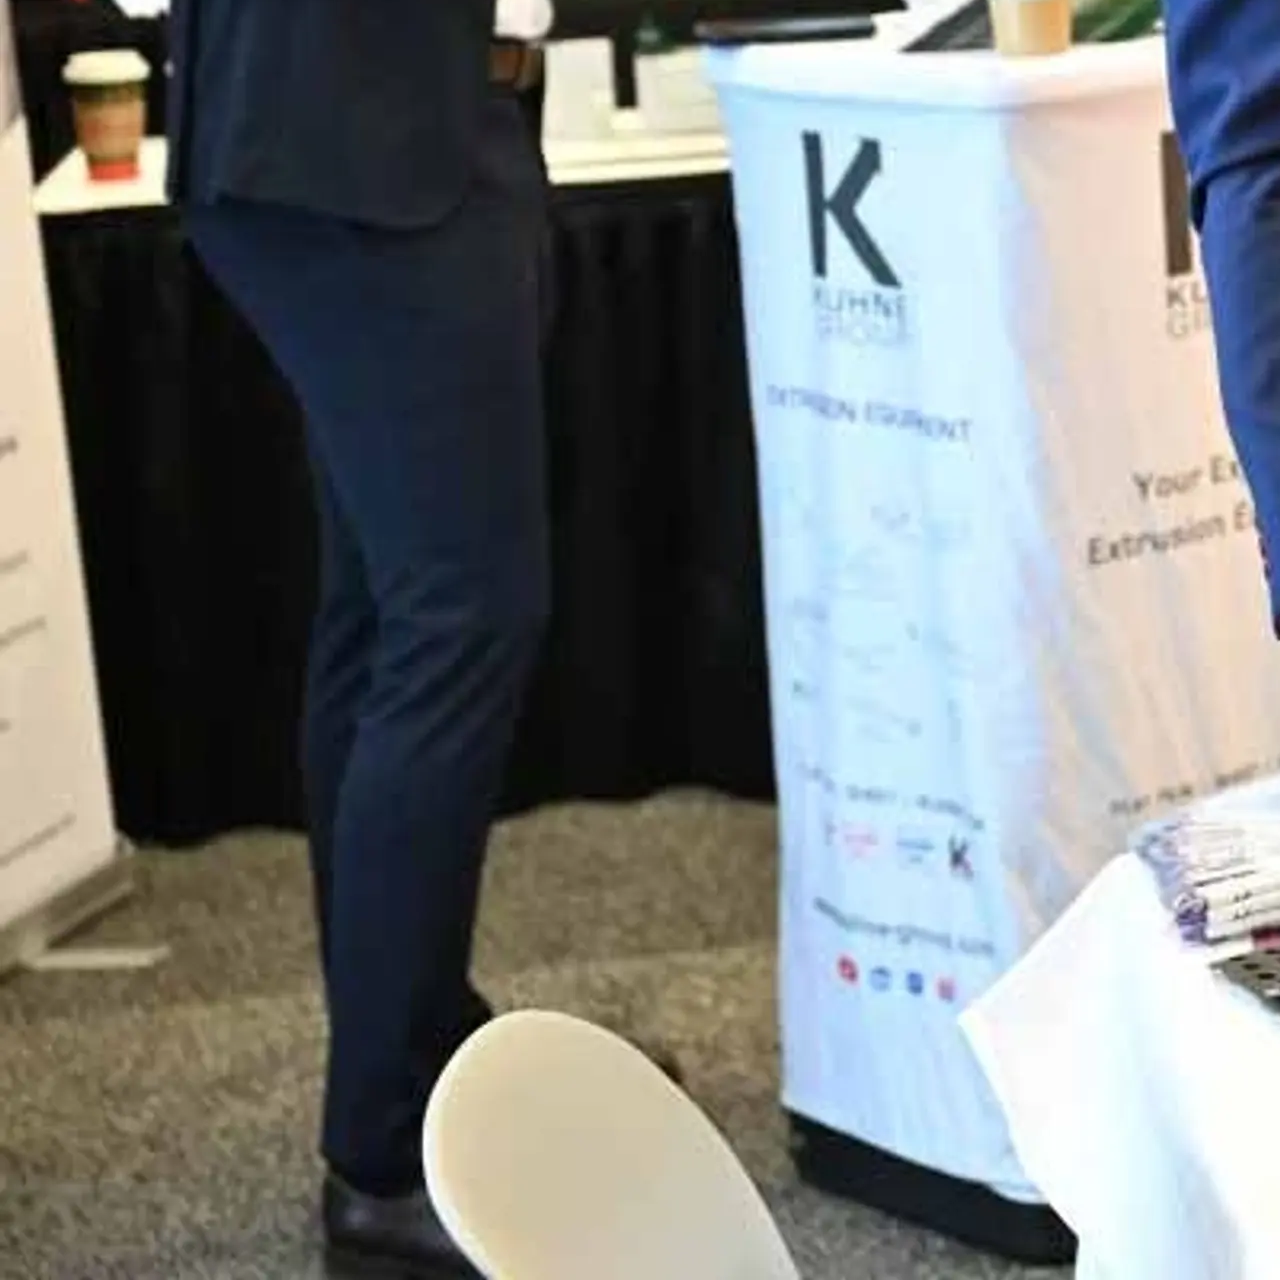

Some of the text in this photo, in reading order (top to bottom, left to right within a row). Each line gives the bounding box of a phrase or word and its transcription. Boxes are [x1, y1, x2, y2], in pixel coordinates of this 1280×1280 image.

[800, 130, 902, 289] K
[1131, 453, 1240, 504] Your Ex
[1088, 516, 1227, 565] Extrusion
